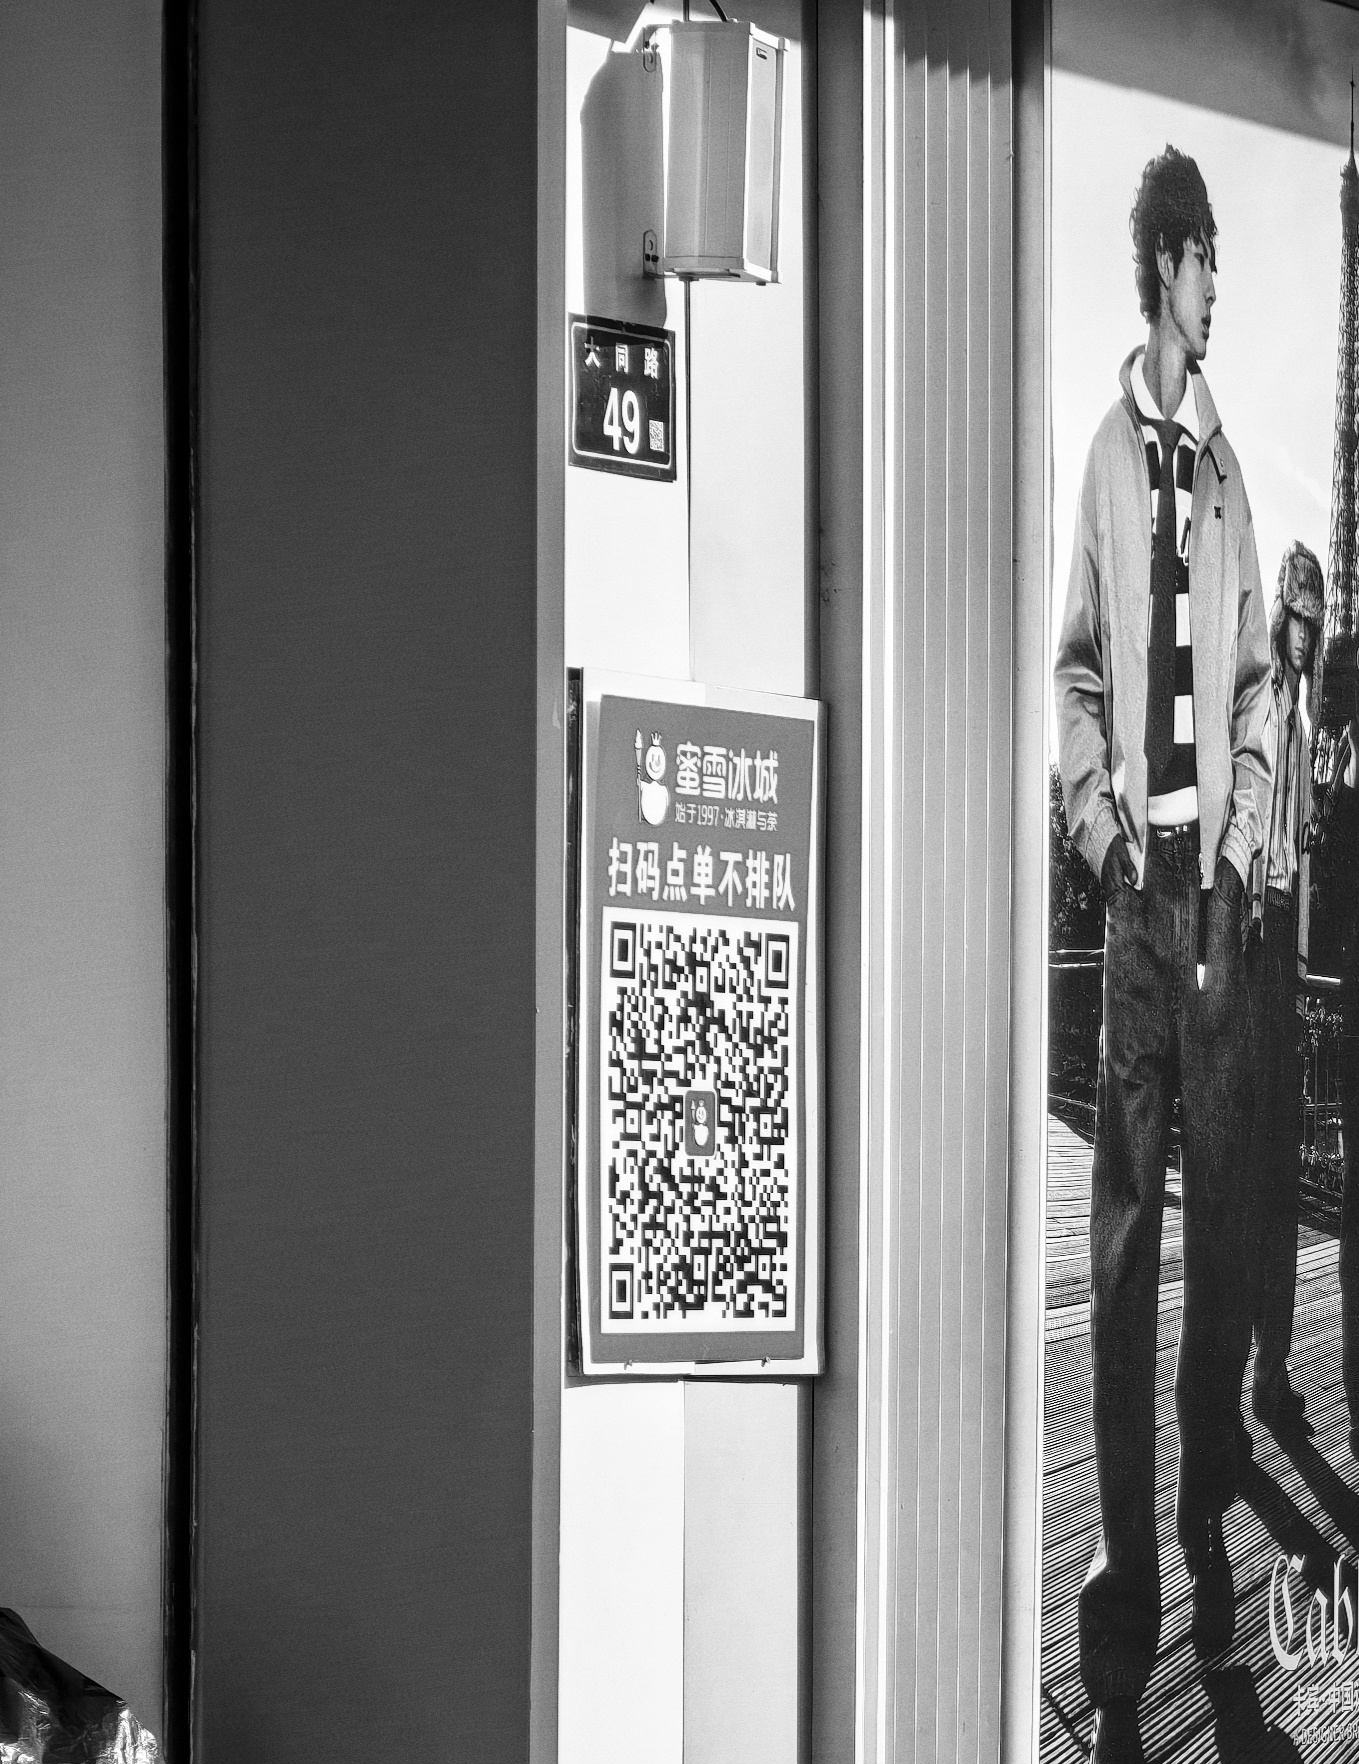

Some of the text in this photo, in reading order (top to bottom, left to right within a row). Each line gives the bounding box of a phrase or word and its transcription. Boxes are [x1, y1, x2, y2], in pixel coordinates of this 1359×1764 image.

[583, 336, 662, 380] 大同路
[602, 386, 641, 455] 49
[674, 740, 779, 805] 蜜雪冰城
[607, 837, 797, 912] 扫码点单不排队
[1301, 1723, 1345, 1745] DESIGNER
